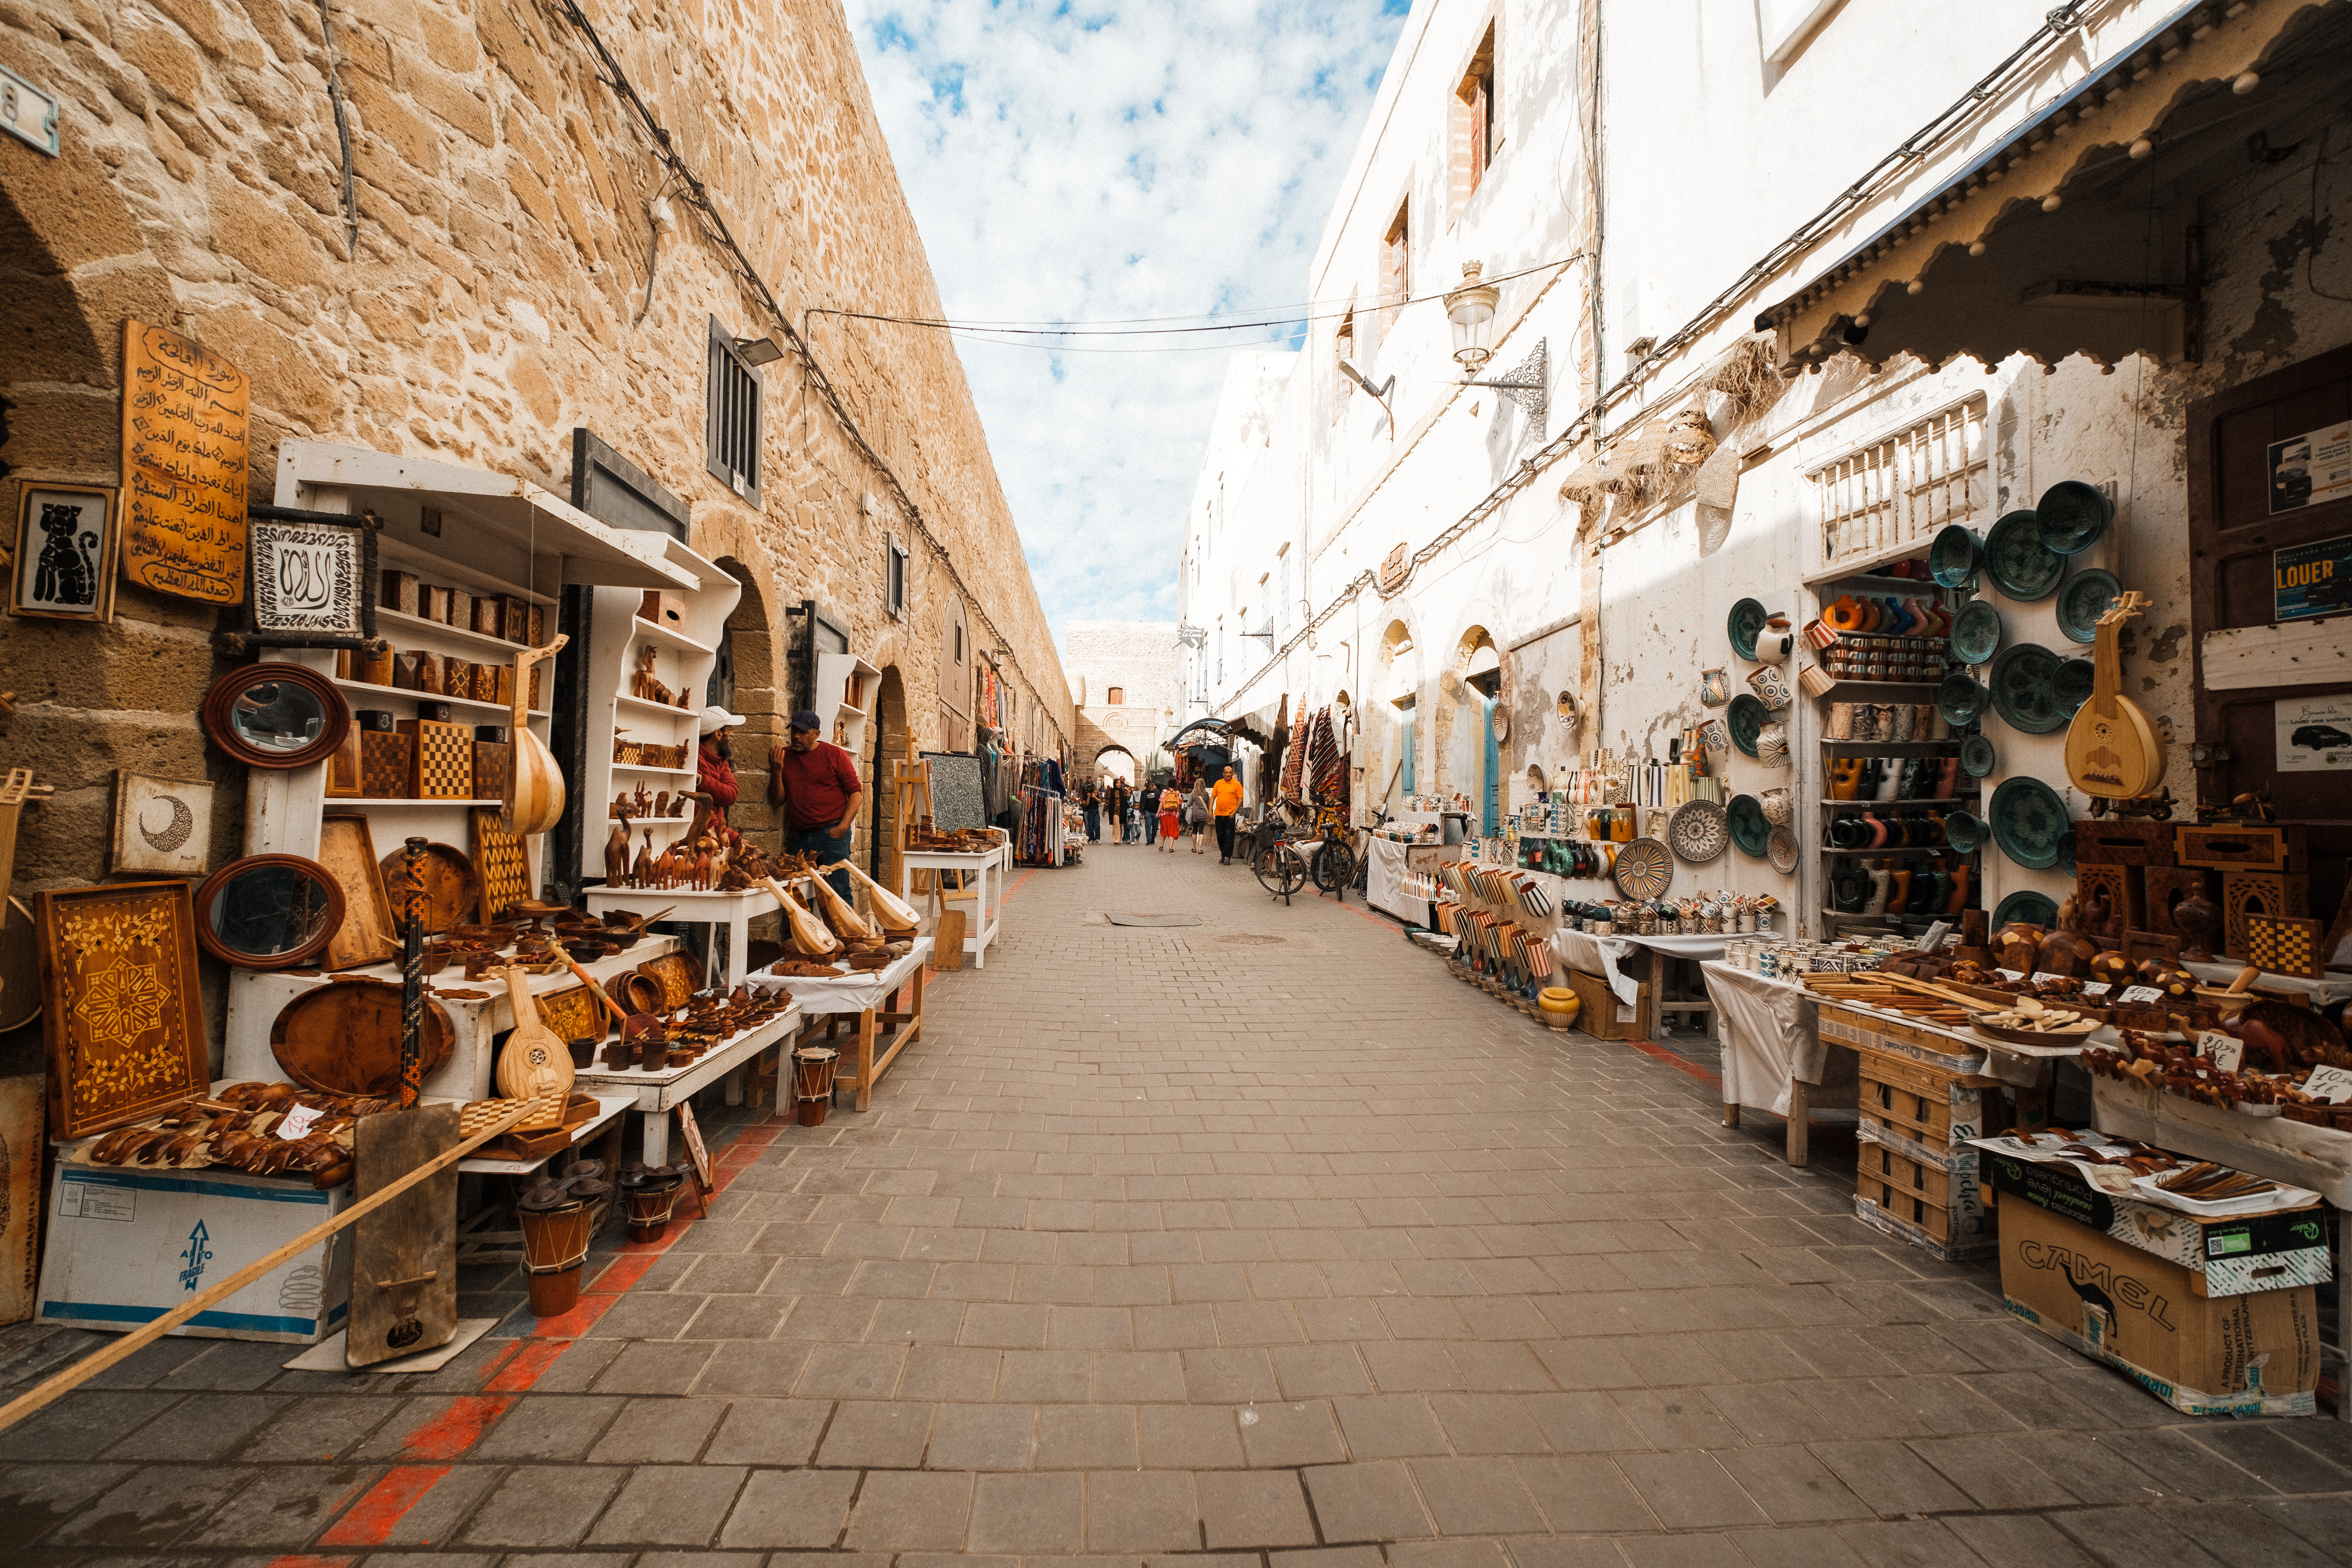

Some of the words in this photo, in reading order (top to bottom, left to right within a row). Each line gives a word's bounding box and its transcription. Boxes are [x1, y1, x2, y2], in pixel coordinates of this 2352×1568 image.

[2, 82, 19, 121] 8
[2277, 559, 2334, 589] LOUER
[1885, 1041, 1908, 1054] Lindab
[2026, 1166, 2092, 1201] Portuguesa
[2027, 1178, 2052, 1197] leve
[2027, 1191, 2048, 1207] fresca
[2051, 1202, 2092, 1224] saborosa
[179, 1263, 205, 1282] FRAGILE
[2019, 1240, 2176, 1332] CAMEL
[2222, 1317, 2231, 1331] OF
[2222, 1334, 2233, 1379] PRODUCT
[2232, 1305, 2245, 1384] INTERNATIONAL
